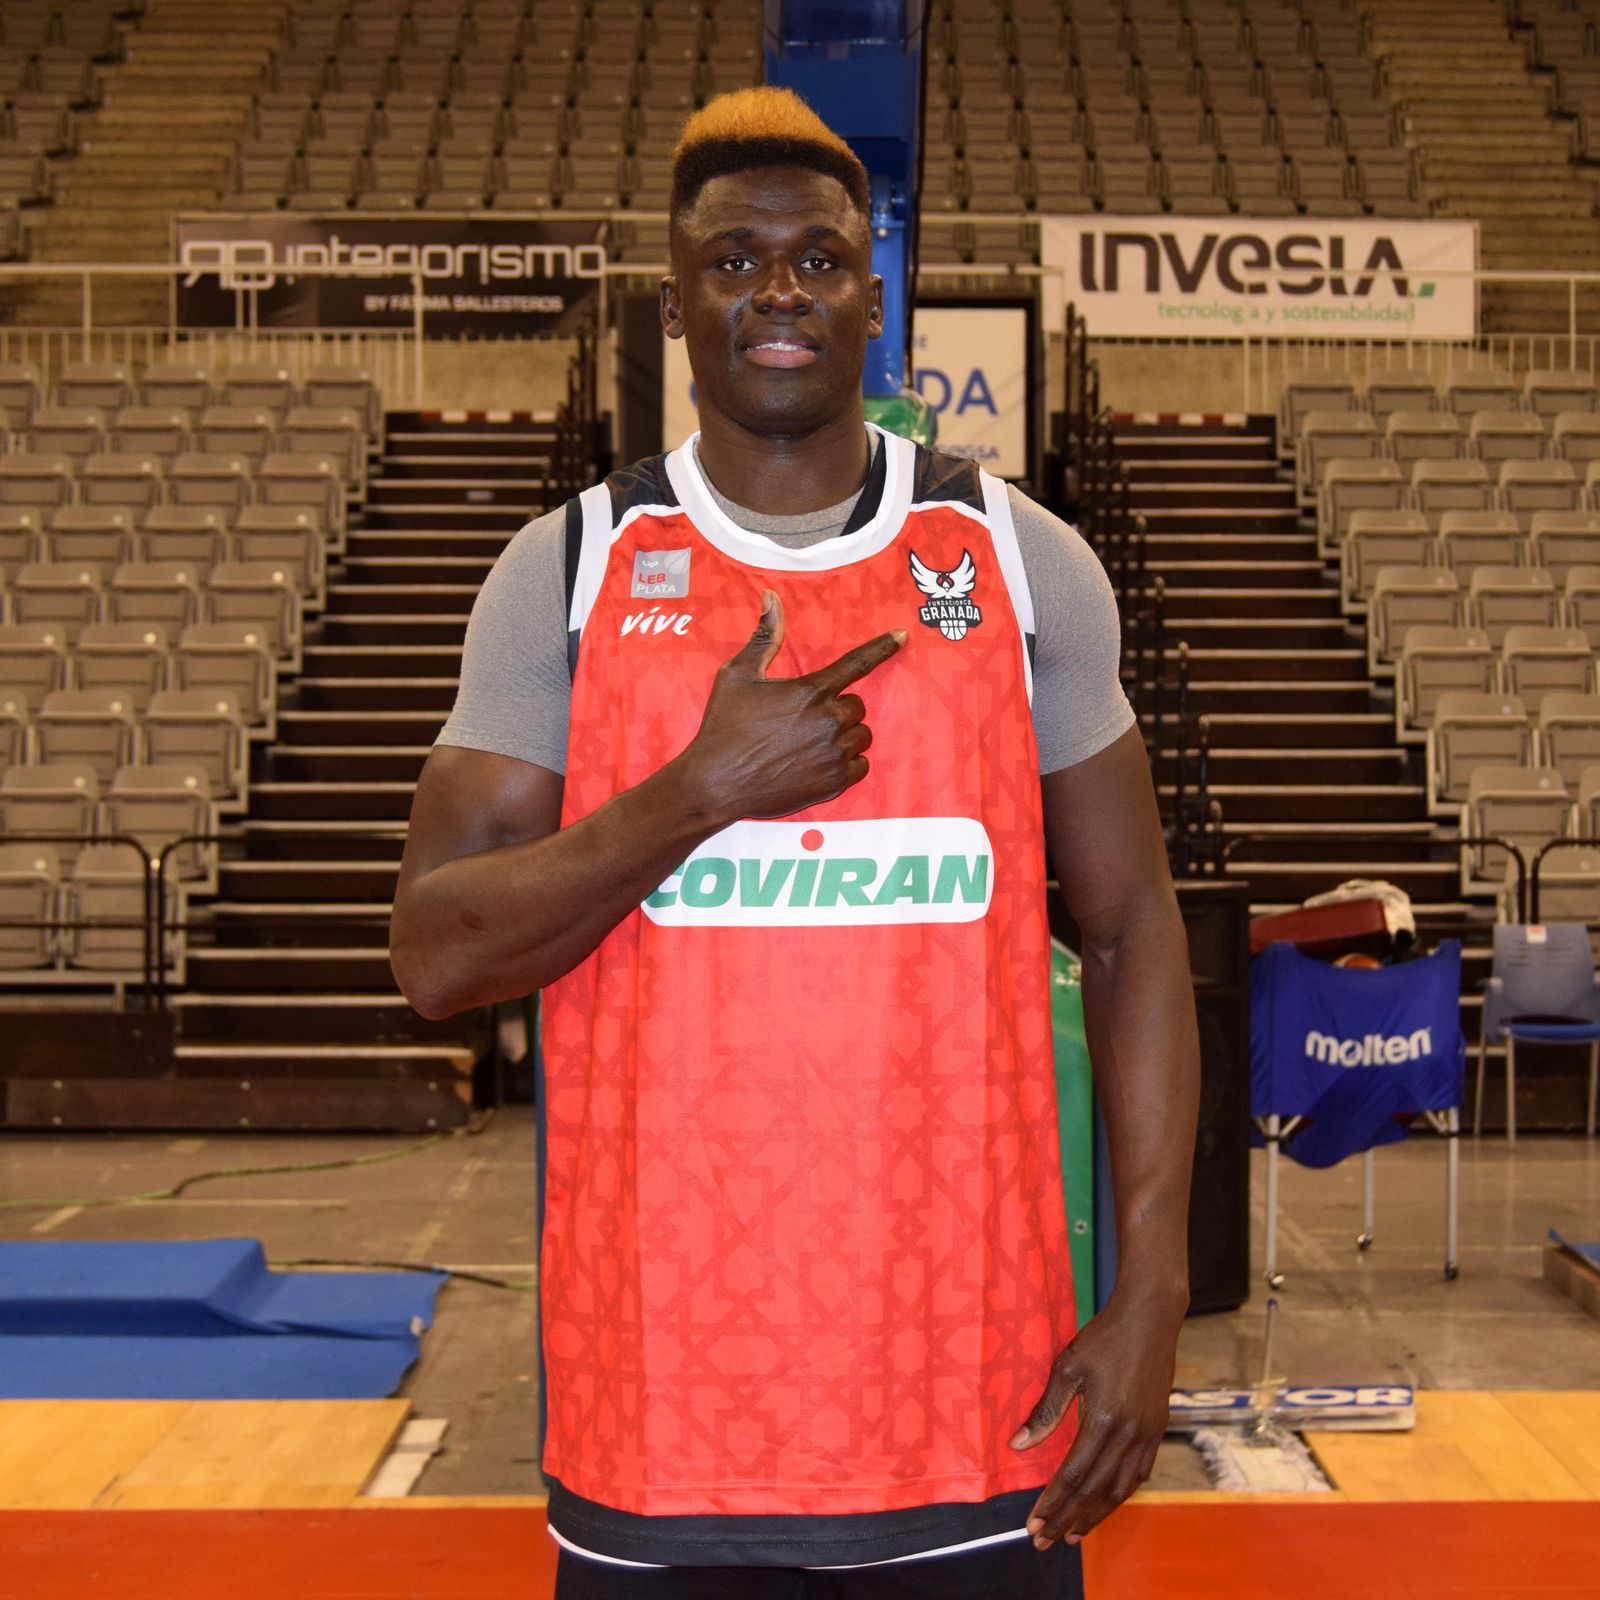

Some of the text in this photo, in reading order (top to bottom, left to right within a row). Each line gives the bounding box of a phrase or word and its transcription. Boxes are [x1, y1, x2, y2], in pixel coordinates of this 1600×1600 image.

[285, 234, 607, 285] interiorismo
[364, 293, 563, 312] BY FÁMA BALLESTEROS
[1157, 302, 1416, 324] tecnologa y sostenibilidad
[638, 572, 666, 584] LEB
[637, 584, 676, 594] PLATA
[920, 605, 981, 621] GRANADA
[1305, 1030, 1432, 1067] molten
